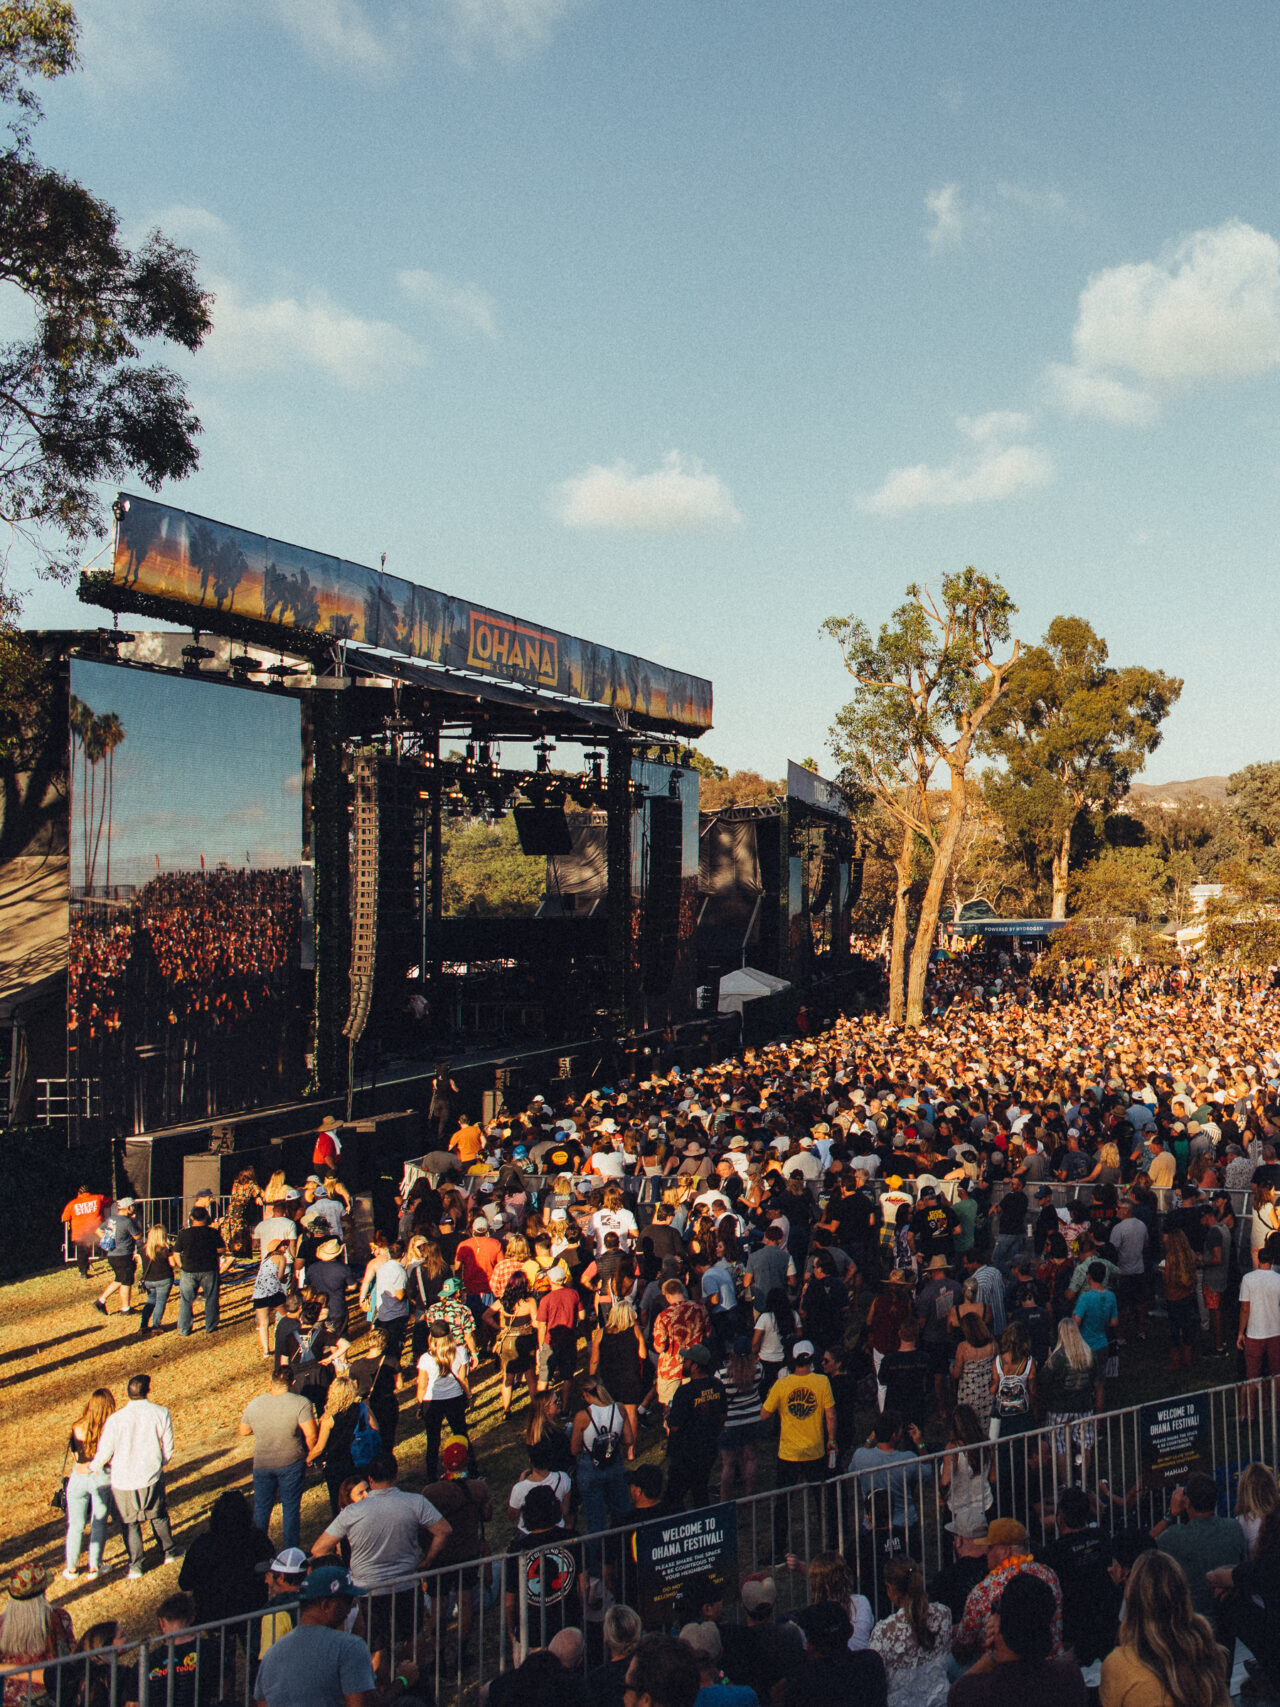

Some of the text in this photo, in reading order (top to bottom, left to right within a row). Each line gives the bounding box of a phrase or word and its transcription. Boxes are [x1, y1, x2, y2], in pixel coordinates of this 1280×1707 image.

[476, 624, 553, 676] OHANA
[74, 1200, 97, 1211] EVENT
[75, 1206, 98, 1216] STAFF
[788, 1388, 816, 1404] WAVE
[788, 1402, 817, 1418] RAVE
[1157, 1403, 1195, 1422] WELCOME TO
[1150, 1414, 1200, 1436] OHANA FESTIVAL!
[1164, 1466, 1189, 1477] MAHALO
[662, 1517, 716, 1543] WELCOME TO
[651, 1529, 724, 1560] OHANA FESTIVAL!
[655, 1548, 722, 1571] PLEASE SHARE THE SPACE
[675, 1559, 708, 1572] COURTEOUS
[664, 1572, 681, 1581] YOUR
